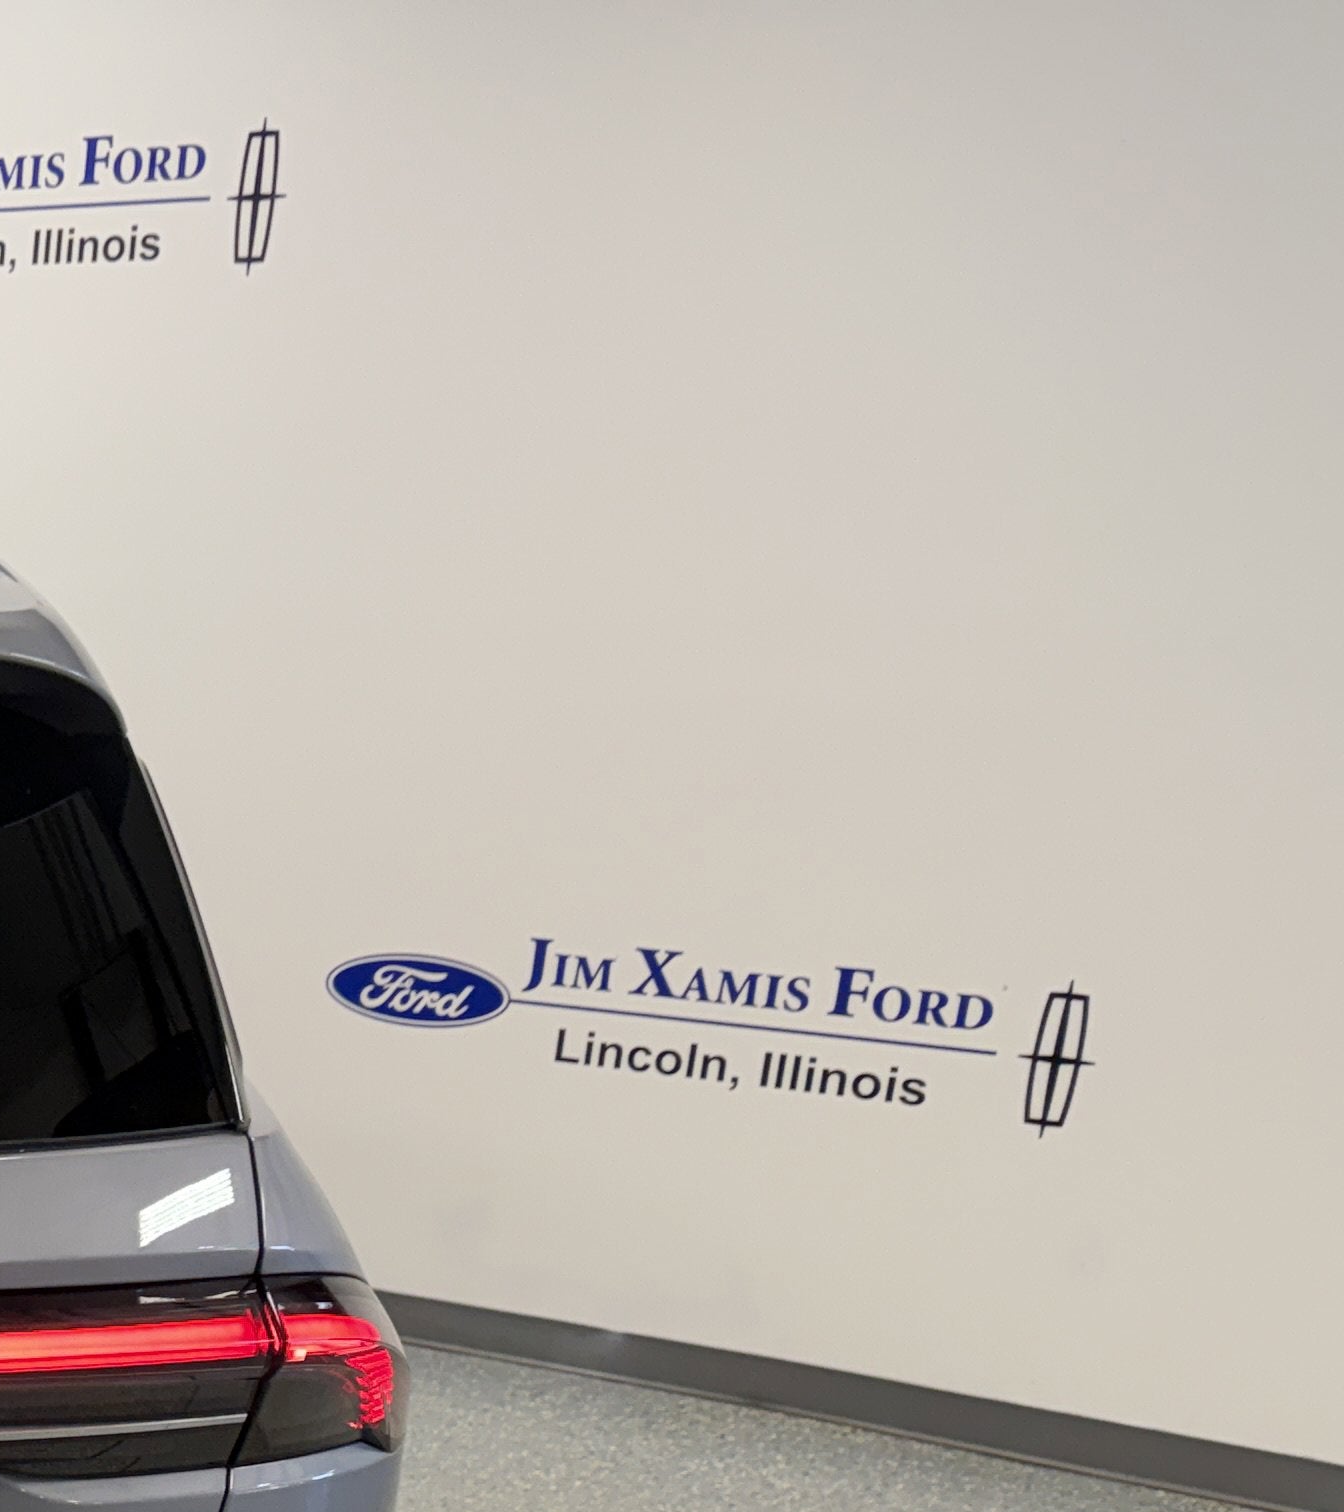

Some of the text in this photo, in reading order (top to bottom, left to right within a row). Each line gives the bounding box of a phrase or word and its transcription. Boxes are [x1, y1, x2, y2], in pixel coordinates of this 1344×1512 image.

[79, 134, 207, 186] FORD
[31, 225, 161, 267] Illinois
[358, 963, 471, 1020] Ford
[522, 937, 995, 1031] JIM XAMIS FORD
[552, 1028, 928, 1106] Lincoln, Illinois
